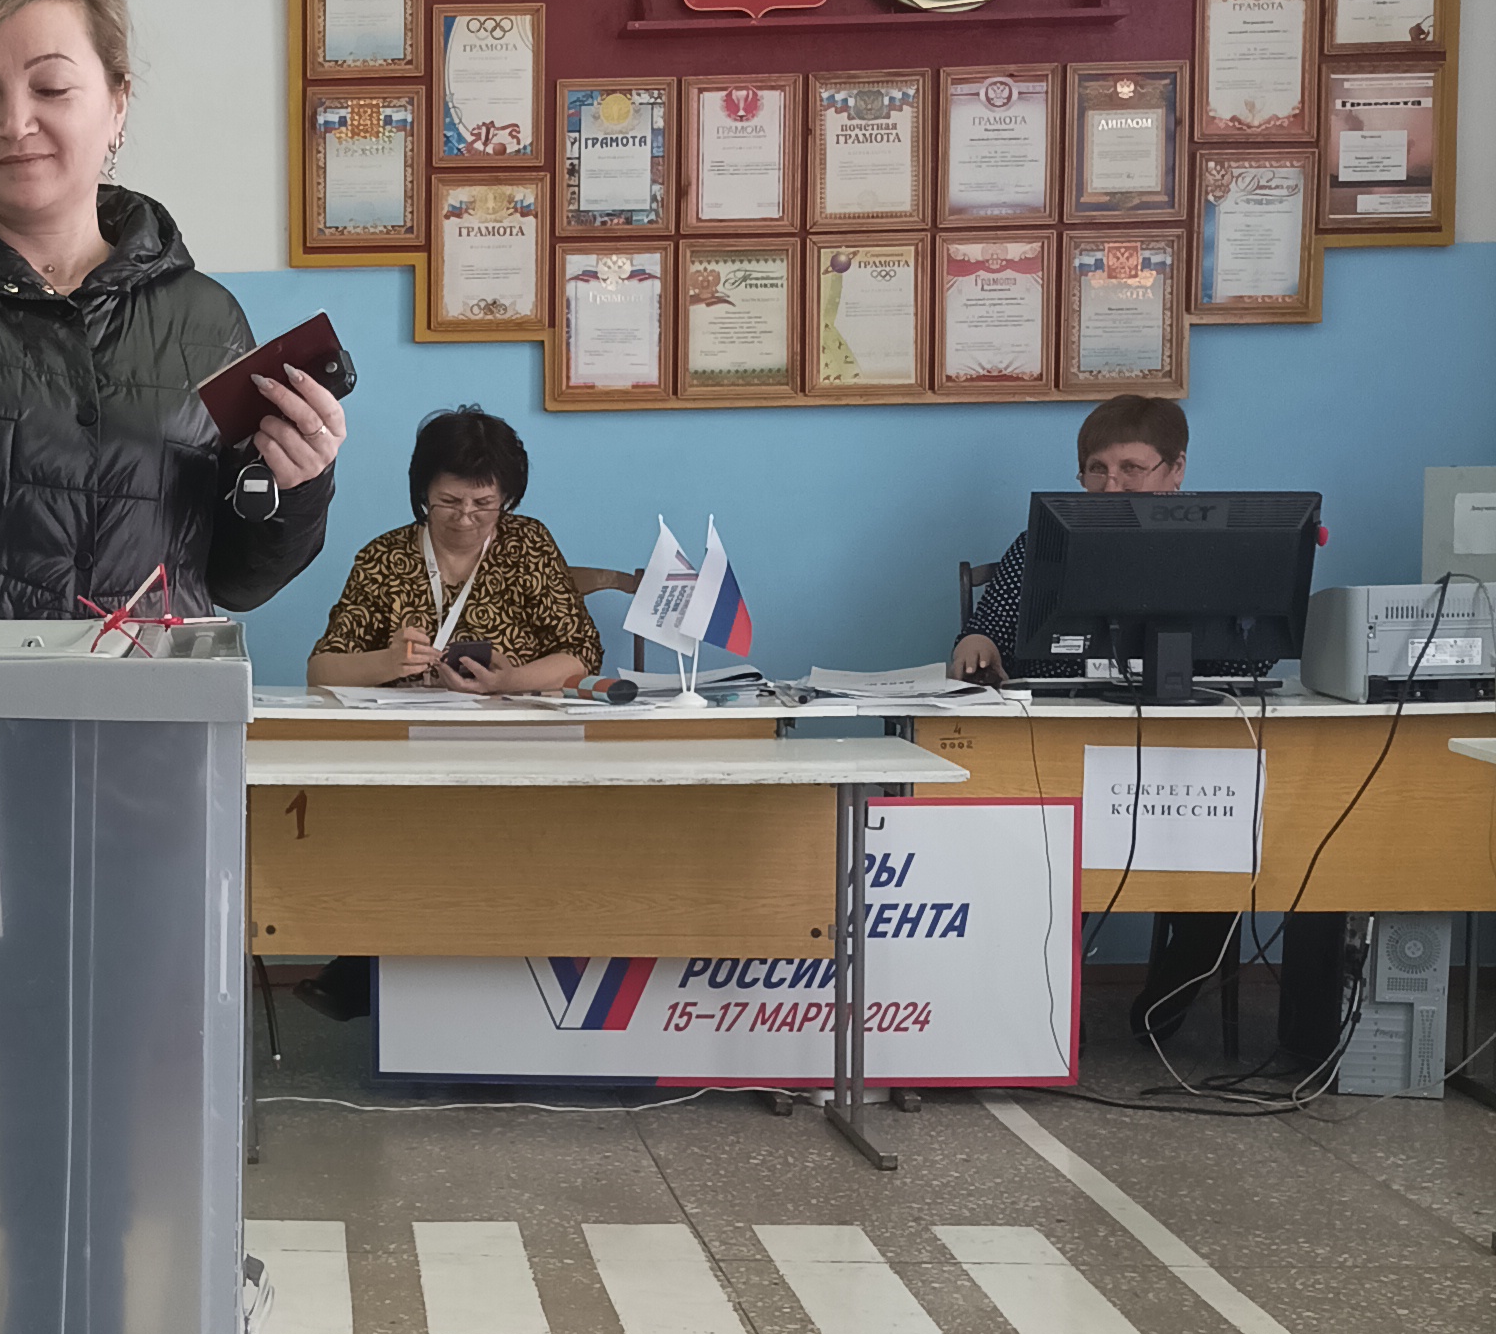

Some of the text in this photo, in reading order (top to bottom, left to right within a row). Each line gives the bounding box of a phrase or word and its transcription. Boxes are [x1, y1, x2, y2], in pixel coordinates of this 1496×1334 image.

[1232, 2, 1284, 12] ГРАМОТА
[462, 43, 519, 54] ГРАМОТА
[972, 115, 1028, 127] ГРАМОТА
[1098, 118, 1152, 131] ДИПЛОМ
[716, 125, 766, 136] ГРАМОТА
[584, 135, 647, 149] ГРАМОТА
[835, 133, 902, 145] ГРАМОТА
[457, 225, 526, 238] ГРАМОТА
[857, 259, 911, 269] ГРАМОТА
[1150, 505, 1216, 522] acer
[954, 722, 961, 735] 4
[940, 740, 973, 749] 0002
[1111, 783, 1236, 797] СЕКРЕТАРЬ
[285, 789, 311, 839] 1
[1111, 804, 1234, 817] КОМИССИИ
[863, 1002, 932, 1032] 2024
